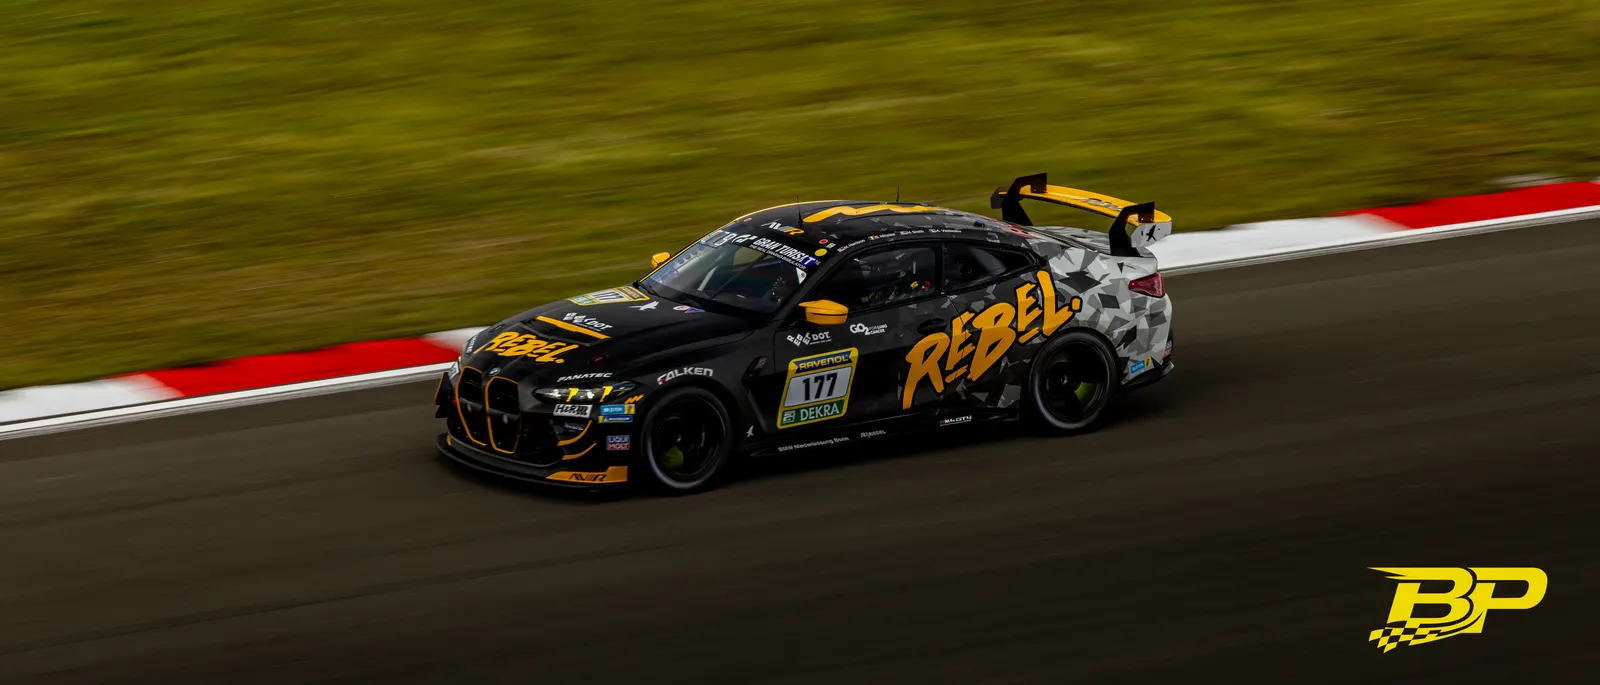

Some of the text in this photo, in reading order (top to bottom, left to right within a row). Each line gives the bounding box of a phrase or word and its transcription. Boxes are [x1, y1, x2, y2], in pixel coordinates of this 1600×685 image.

[753, 238, 782, 250] GRAN
[799, 355, 848, 370] RAVENOL
[557, 372, 613, 382] FANATEC
[657, 367, 713, 385] FALKEN
[802, 373, 838, 401] 177
[800, 404, 839, 421] DEKRA
